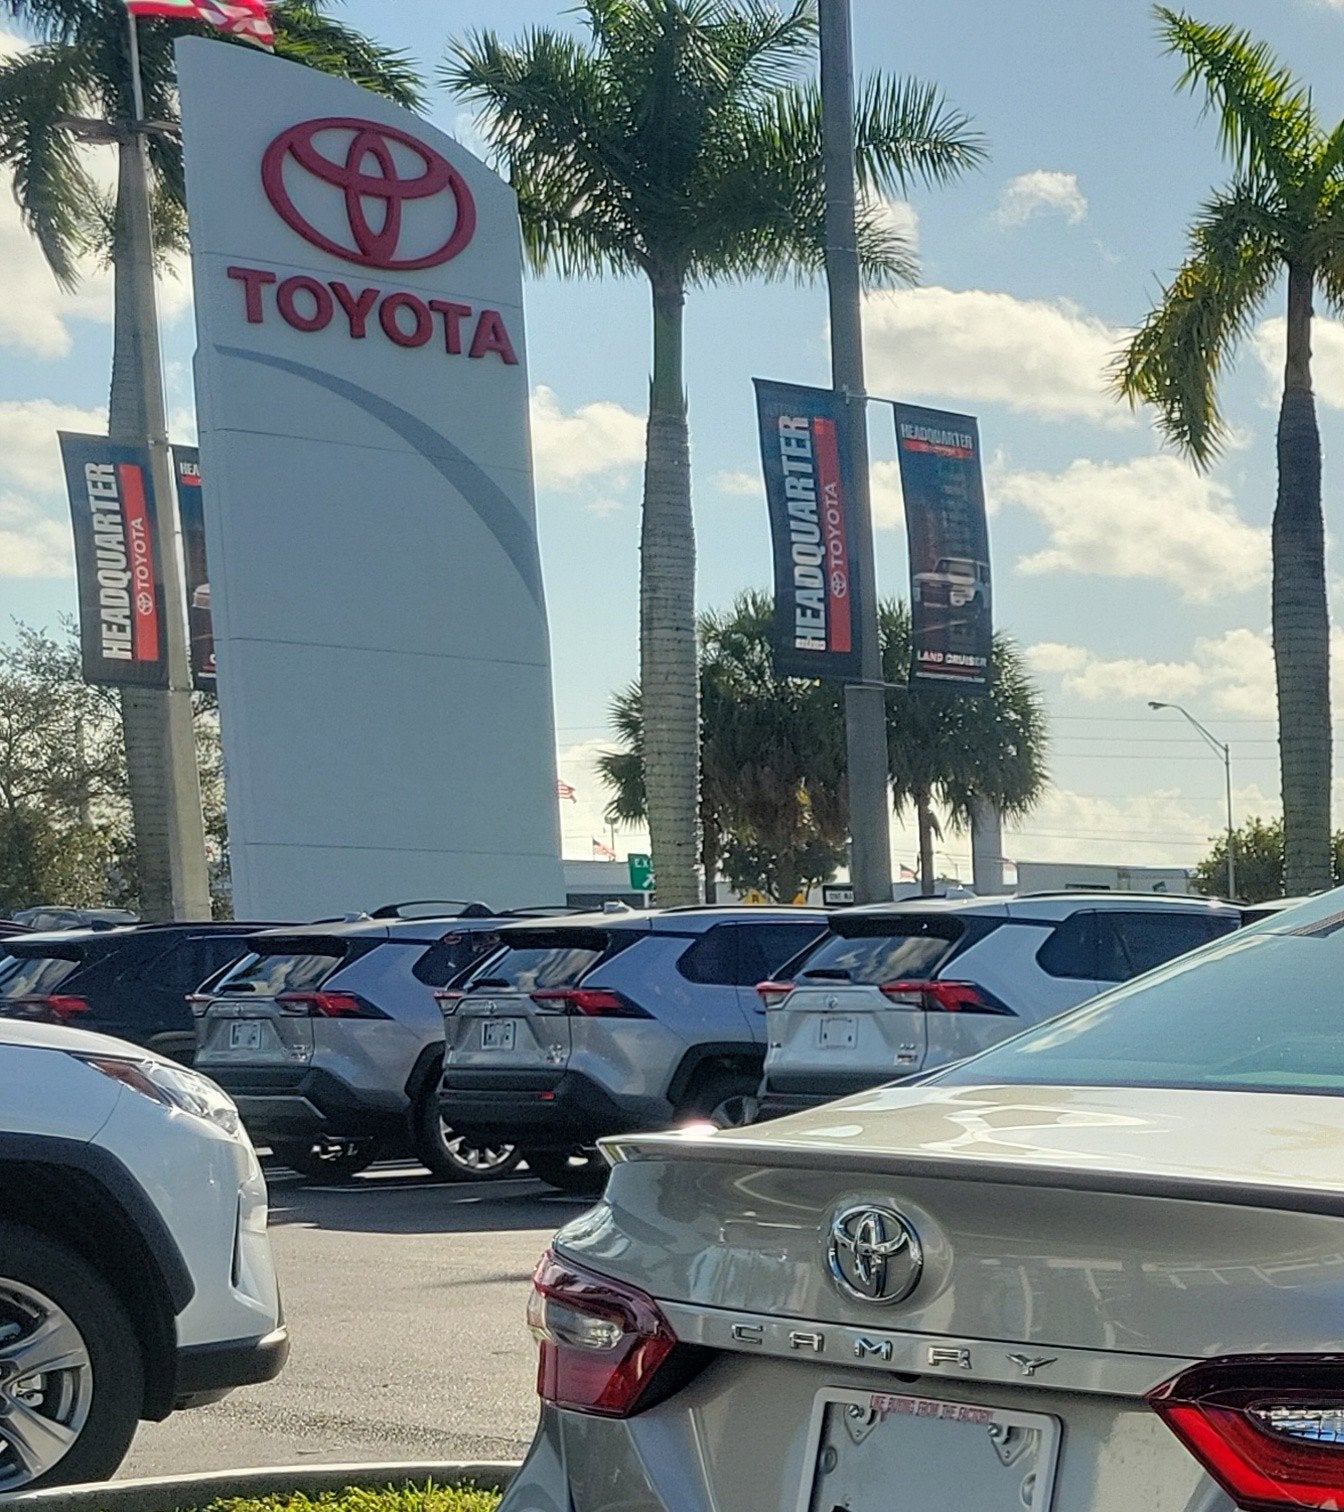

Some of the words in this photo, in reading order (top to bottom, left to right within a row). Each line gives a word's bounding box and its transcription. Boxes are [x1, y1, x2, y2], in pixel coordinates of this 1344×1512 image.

[227, 266, 519, 365] TOYOTA
[84, 462, 133, 660] HEADQUARTER
[130, 517, 153, 588] TOYOTA
[779, 415, 826, 650] HEADQUARTER
[823, 482, 844, 566] TOYOTA
[917, 649, 944, 662] LAND
[731, 1323, 1058, 1377] CAMRY
